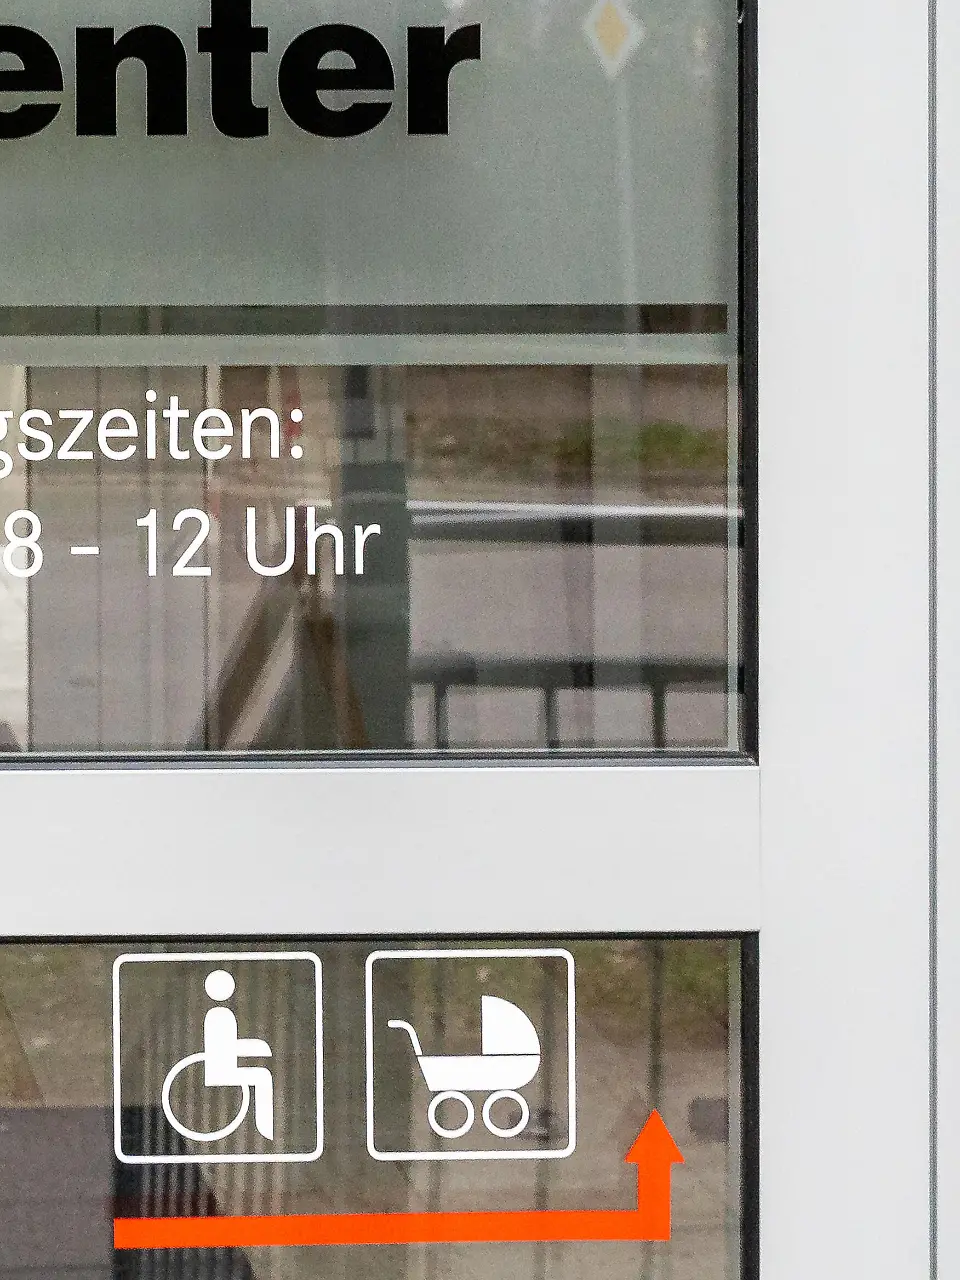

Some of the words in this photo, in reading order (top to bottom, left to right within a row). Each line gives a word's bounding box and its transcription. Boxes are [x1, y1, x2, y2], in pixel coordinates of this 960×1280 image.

[3, 508, 43, 579] 8
[136, 508, 213, 578] 12
[245, 505, 381, 578] Uhr
